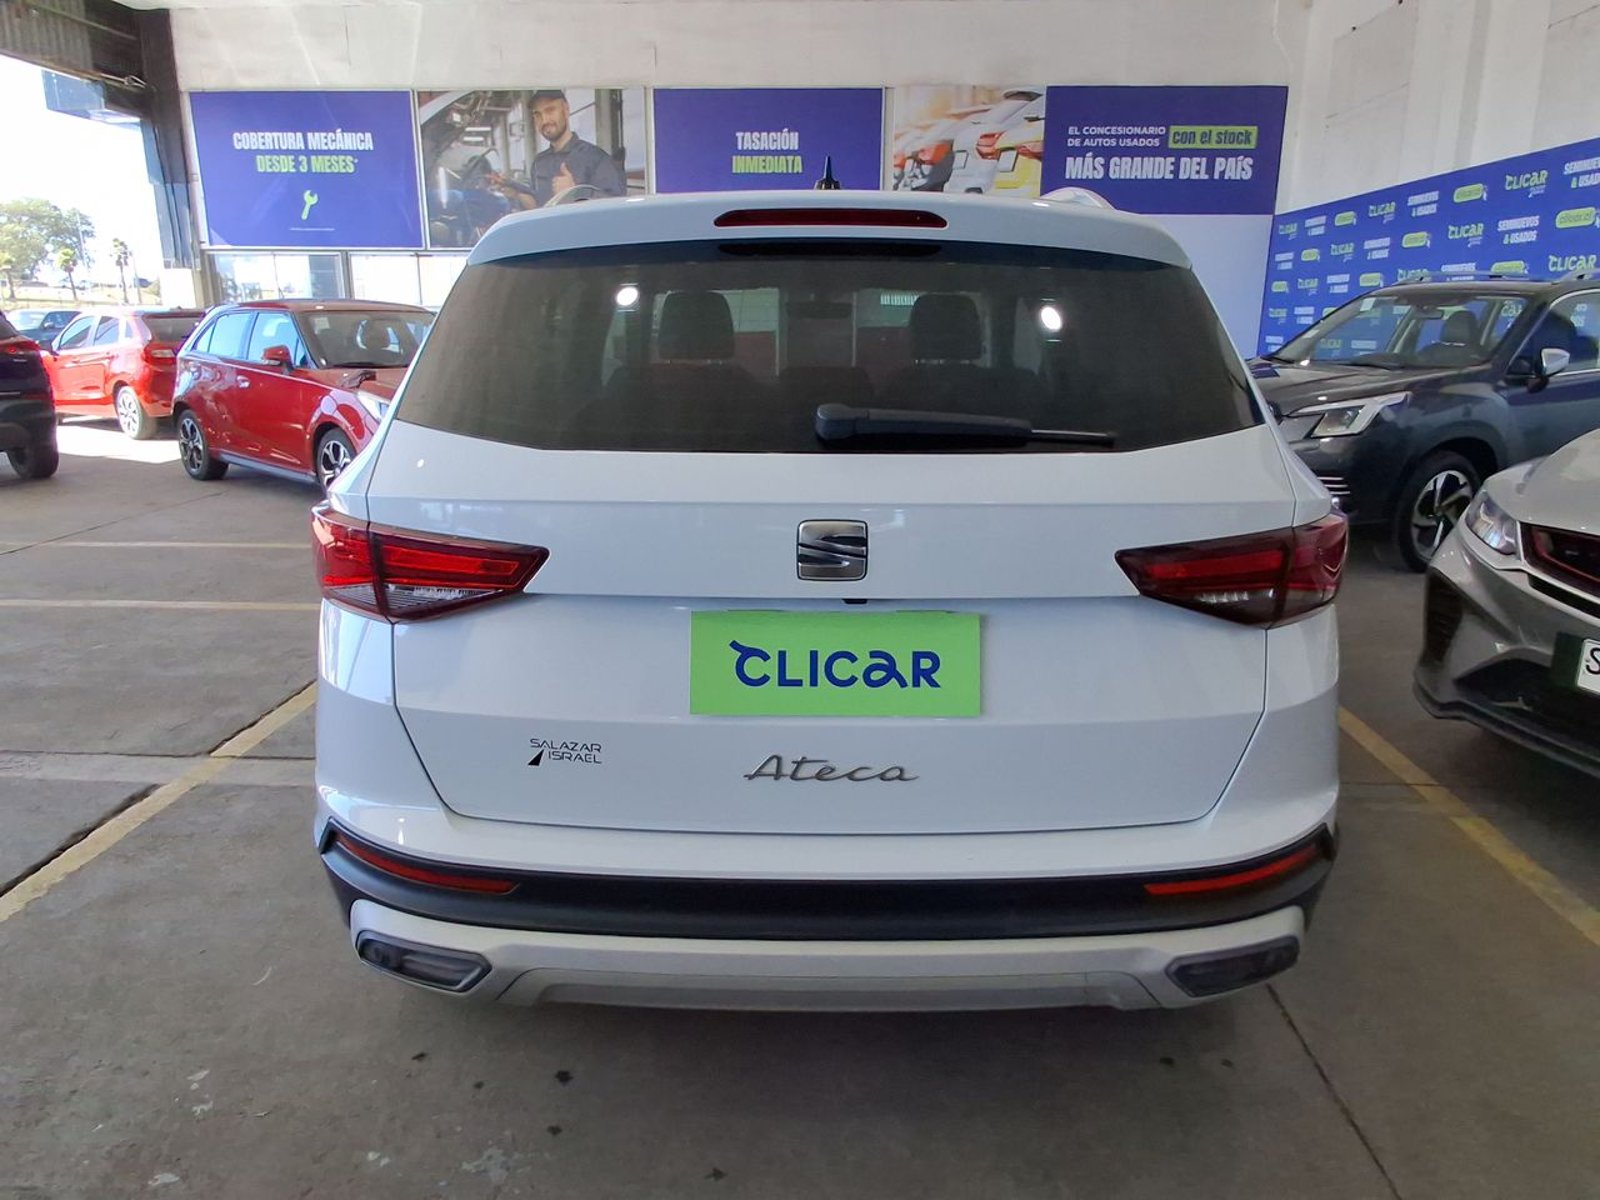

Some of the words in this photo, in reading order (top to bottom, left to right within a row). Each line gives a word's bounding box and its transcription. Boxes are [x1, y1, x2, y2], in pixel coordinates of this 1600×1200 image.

[1068, 126, 1080, 135] EL
[1082, 126, 1166, 135] CONCESIONARIO
[1172, 130, 1196, 144] con
[1200, 129, 1212, 143] el
[1215, 129, 1252, 144] stock
[233, 132, 305, 150] COBERTURA
[307, 128, 374, 151] MECÁNICA
[736, 128, 800, 151] TASACIÓN
[1067, 138, 1081, 147] DE
[1083, 138, 1117, 147] AUTOS
[1119, 138, 1160, 147] USADOS
[256, 156, 296, 173] DESDE
[299, 156, 309, 173] 3
[732, 156, 803, 174] INMEDIATA
[1065, 152, 1105, 180] MÁS
[1109, 157, 1175, 180] GRANDE
[1178, 157, 1209, 180] DEL
[1213, 156, 1254, 180] PAÍS
[529, 738, 602, 753] SALAZAR
[548, 750, 602, 764] ISRAEL
[743, 754, 919, 782] Ateca
